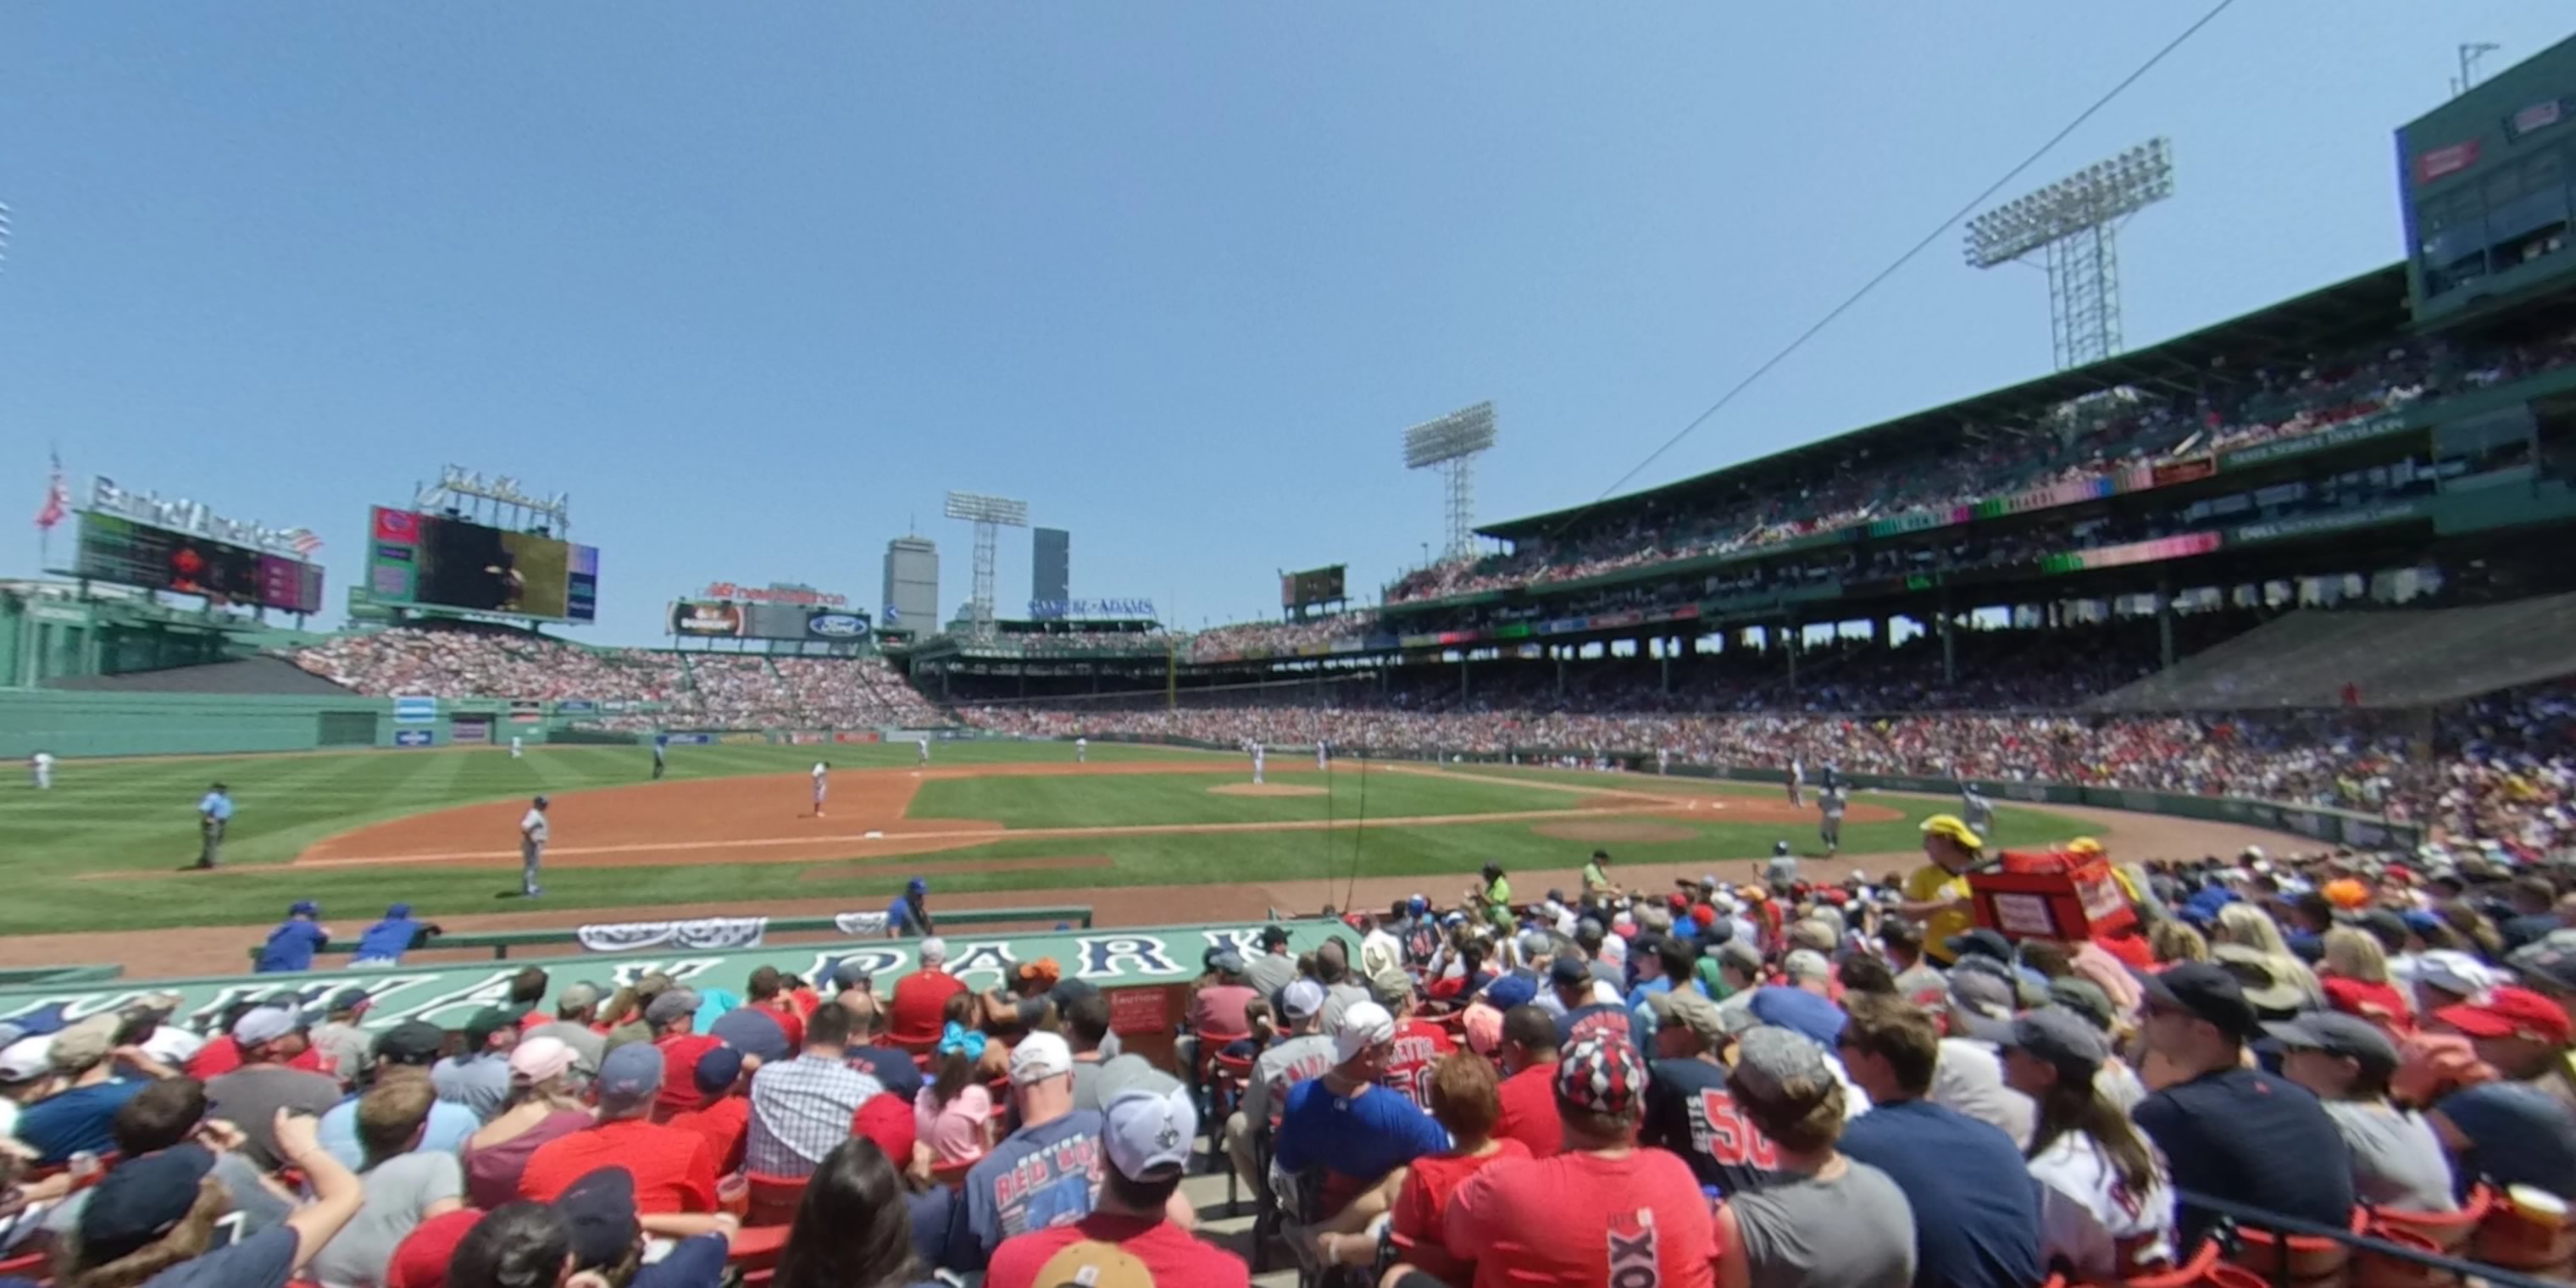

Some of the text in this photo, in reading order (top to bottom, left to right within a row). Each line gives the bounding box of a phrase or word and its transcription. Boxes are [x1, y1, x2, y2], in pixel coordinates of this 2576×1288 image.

[819, 618, 858, 633] Ford
[799, 926, 1301, 1002] PARK
[1685, 1095, 1710, 1154] BETTS
[994, 1158, 1050, 1213] RED
